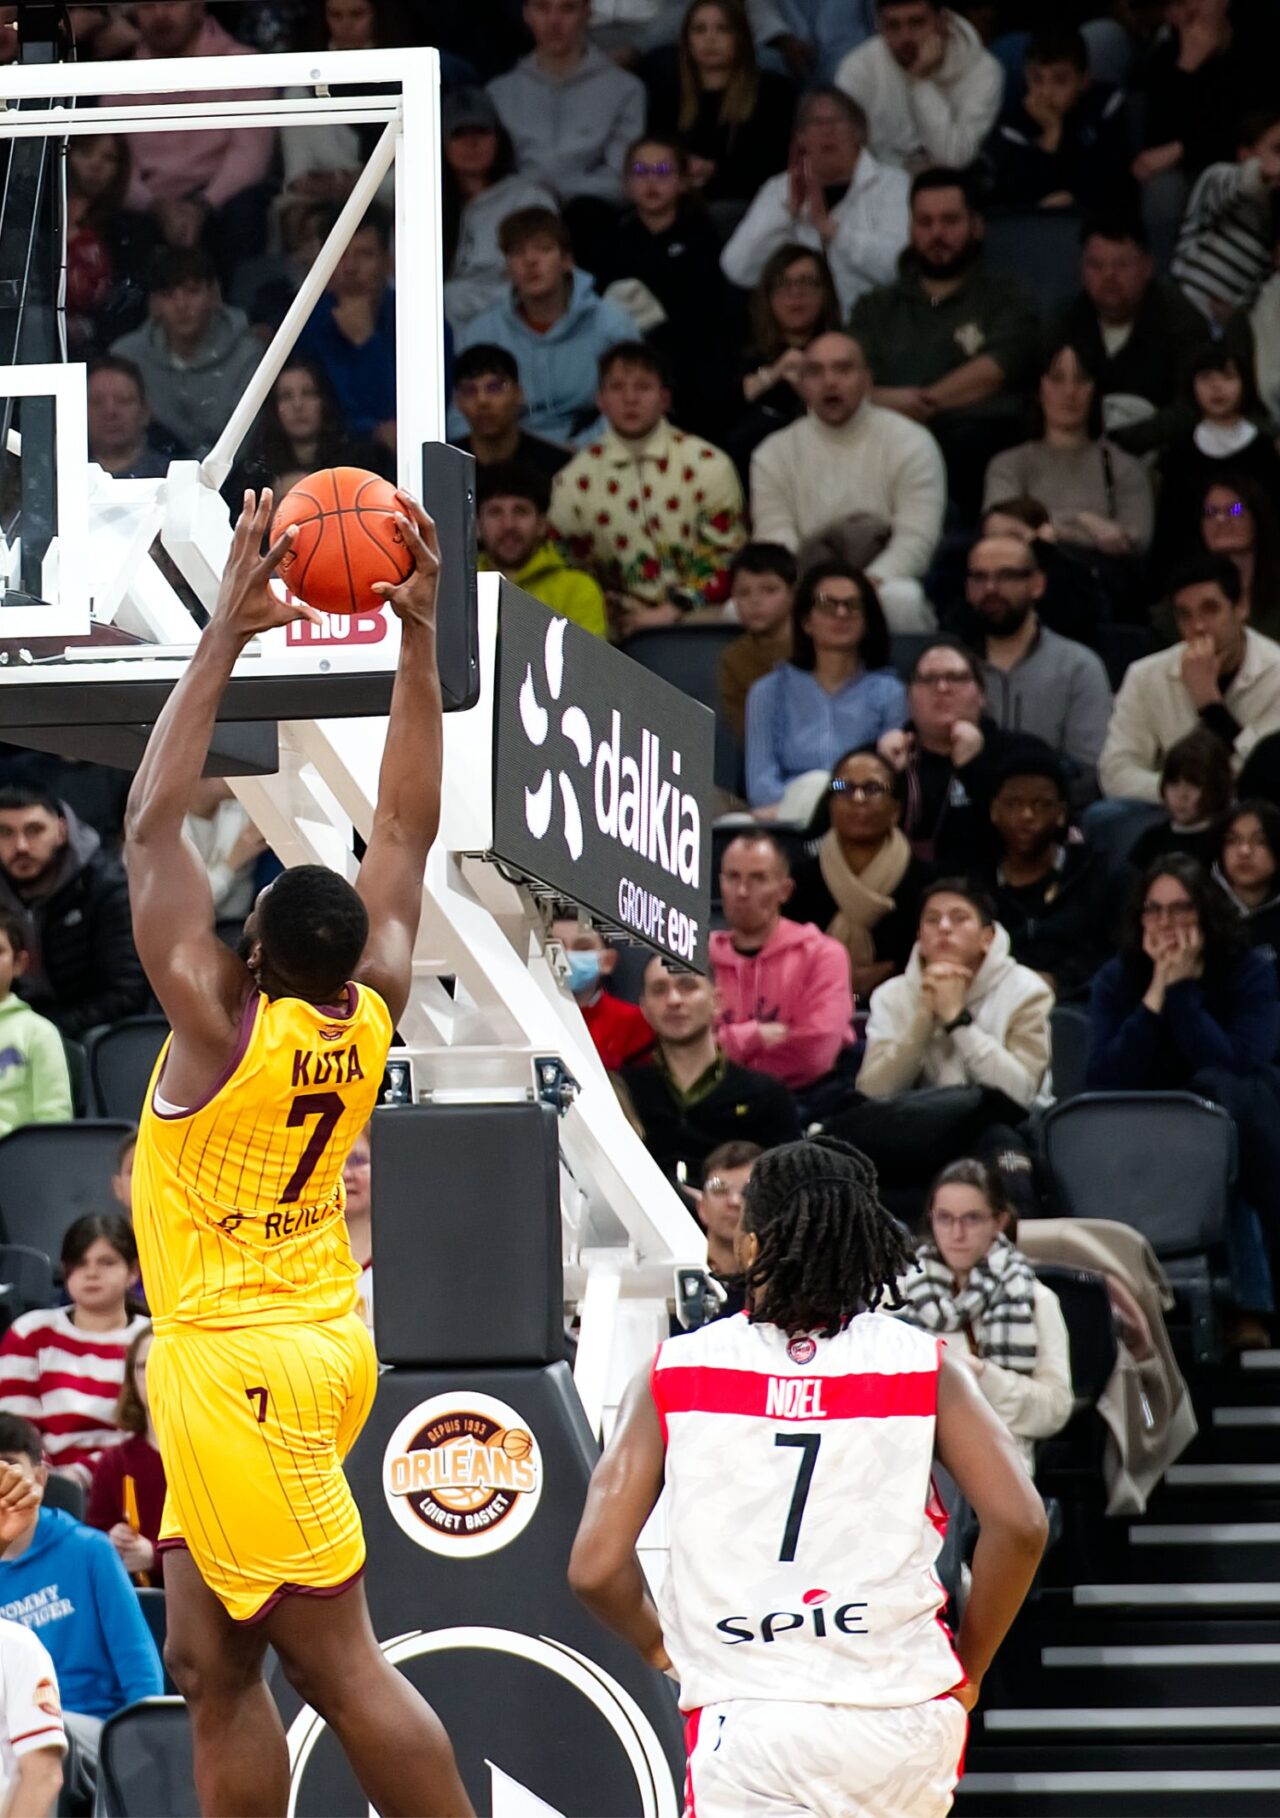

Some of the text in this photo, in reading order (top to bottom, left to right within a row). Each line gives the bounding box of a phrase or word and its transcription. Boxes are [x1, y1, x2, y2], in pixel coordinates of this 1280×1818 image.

[594, 708, 700, 889] dalkia
[619, 876, 665, 944] GROUPE
[292, 1044, 364, 1087] KUTA
[278, 1091, 346, 1204] 7
[245, 1386, 268, 1423] 7
[766, 1376, 827, 1418] NOEL
[427, 1419, 487, 1442] DEPUIS 1993
[419, 1493, 510, 1531] LOIRET BASKET
[775, 1433, 821, 1562] 7
